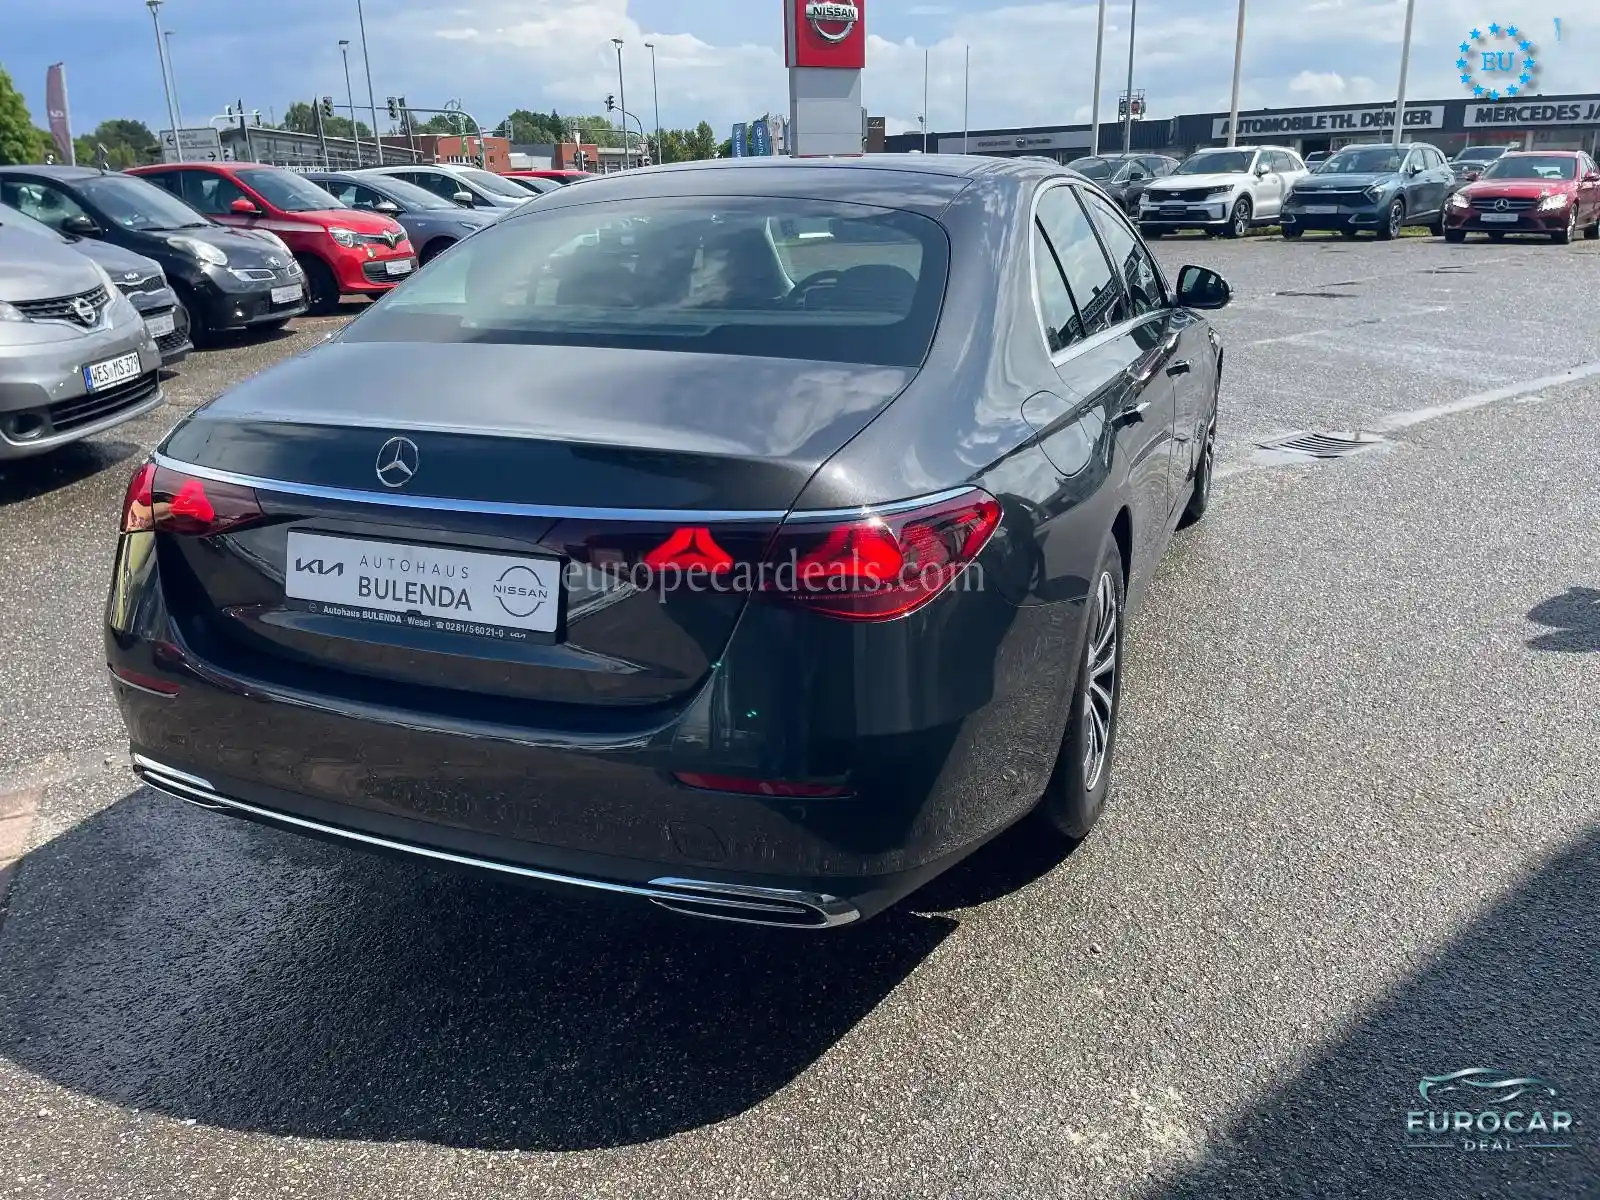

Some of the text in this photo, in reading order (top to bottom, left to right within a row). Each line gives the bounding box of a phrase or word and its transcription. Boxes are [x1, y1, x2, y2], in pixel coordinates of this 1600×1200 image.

[812, 6, 855, 18] NISSAN
[1475, 104, 1580, 123] MERCEDES
[1221, 114, 1327, 135] AUTOMOBILE
[1329, 113, 1357, 129] TH.
[295, 557, 344, 576] KIA
[359, 554, 470, 579] AUTOHAUS
[358, 575, 472, 611] BULENDA
[492, 583, 548, 599] NISSAN
[323, 605, 360, 618] Autohaus
[362, 610, 402, 624] BULENDA
[407, 616, 431, 628] Wesel
